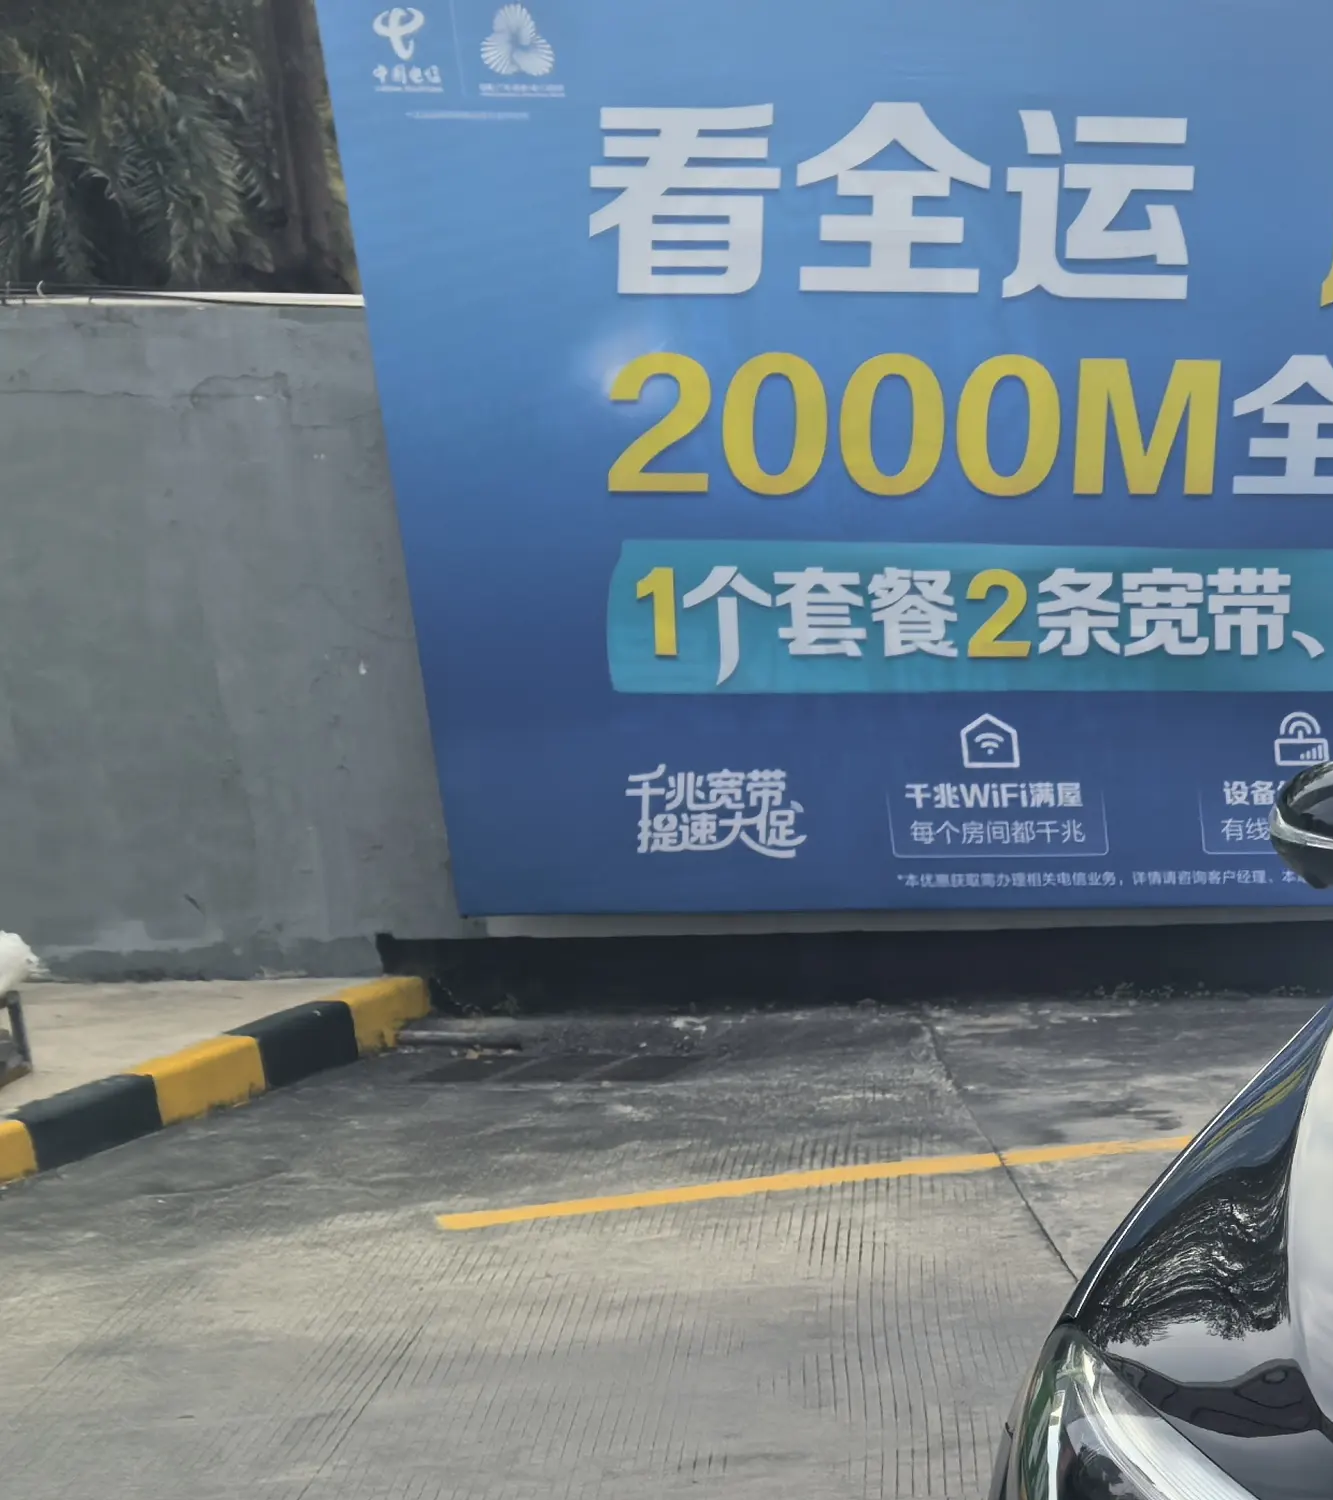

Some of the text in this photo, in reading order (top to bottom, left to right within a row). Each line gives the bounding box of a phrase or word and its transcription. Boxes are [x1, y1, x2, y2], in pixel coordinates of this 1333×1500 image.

[590, 101, 1195, 299] 看全运
[625, 763, 787, 812] 千兆宽带
[904, 782, 1084, 809] 千兆WiFi满屋
[636, 808, 808, 859] 提速大促
[910, 820, 1086, 845] 每个房间都千兆
